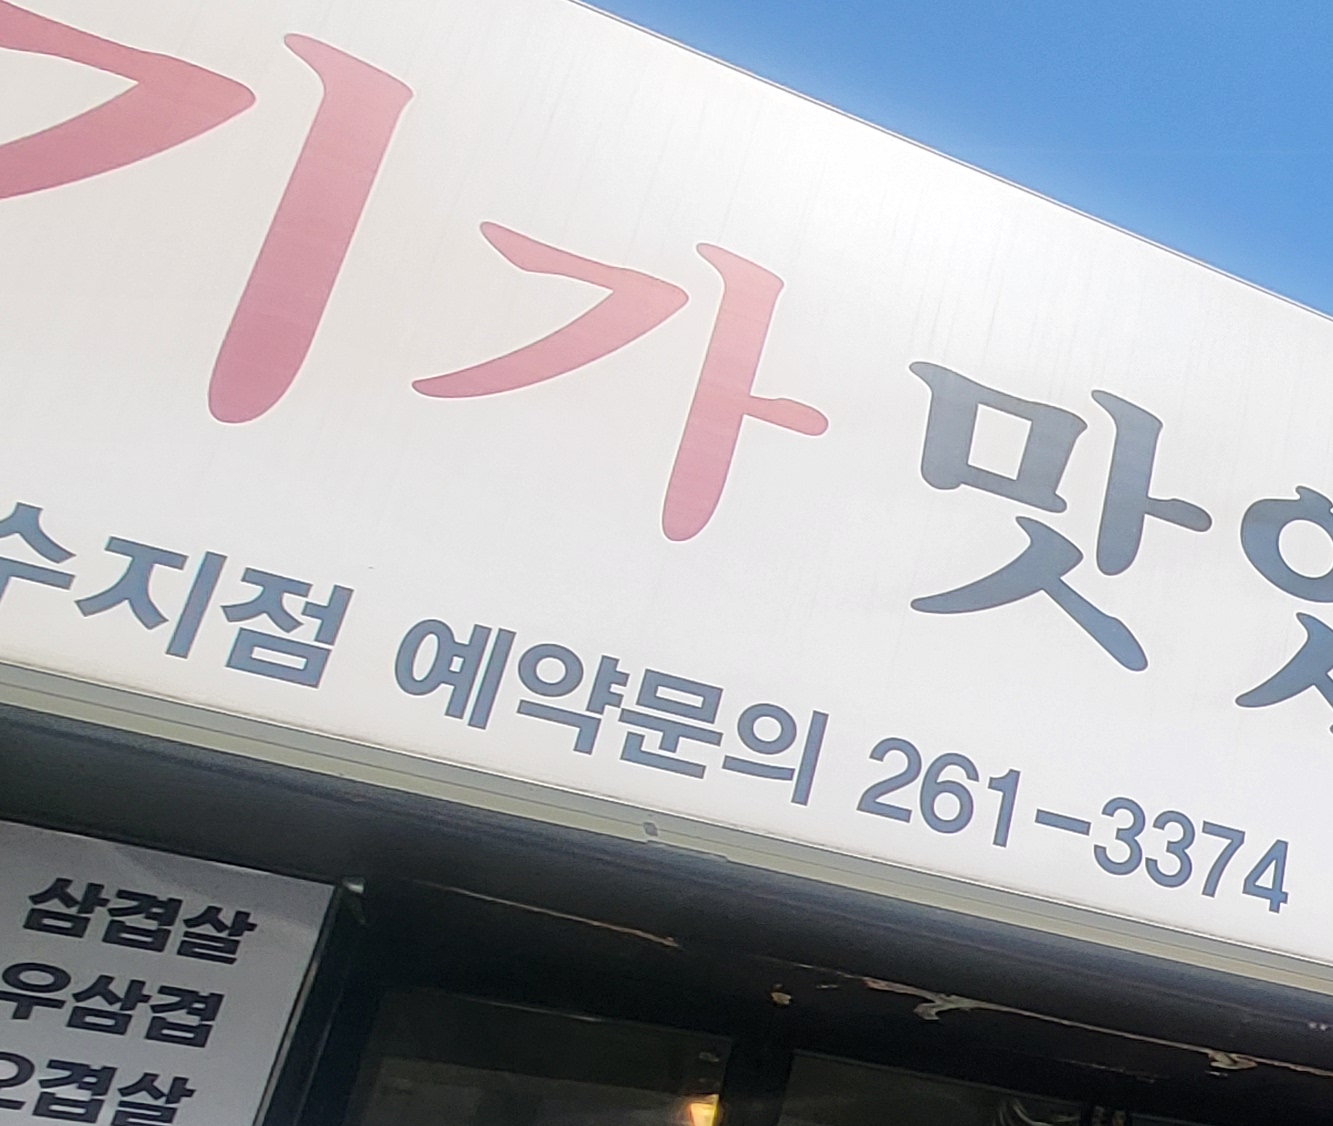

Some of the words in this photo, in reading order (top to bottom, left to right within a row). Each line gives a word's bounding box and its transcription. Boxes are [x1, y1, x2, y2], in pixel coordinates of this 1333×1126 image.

[0, 502, 354, 689] 수지점
[394, 618, 828, 806] 예약문의
[868, 737, 1290, 913] 261-3374
[22, 877, 258, 965] 삼겹살
[0, 962, 225, 1048] 우삼겹
